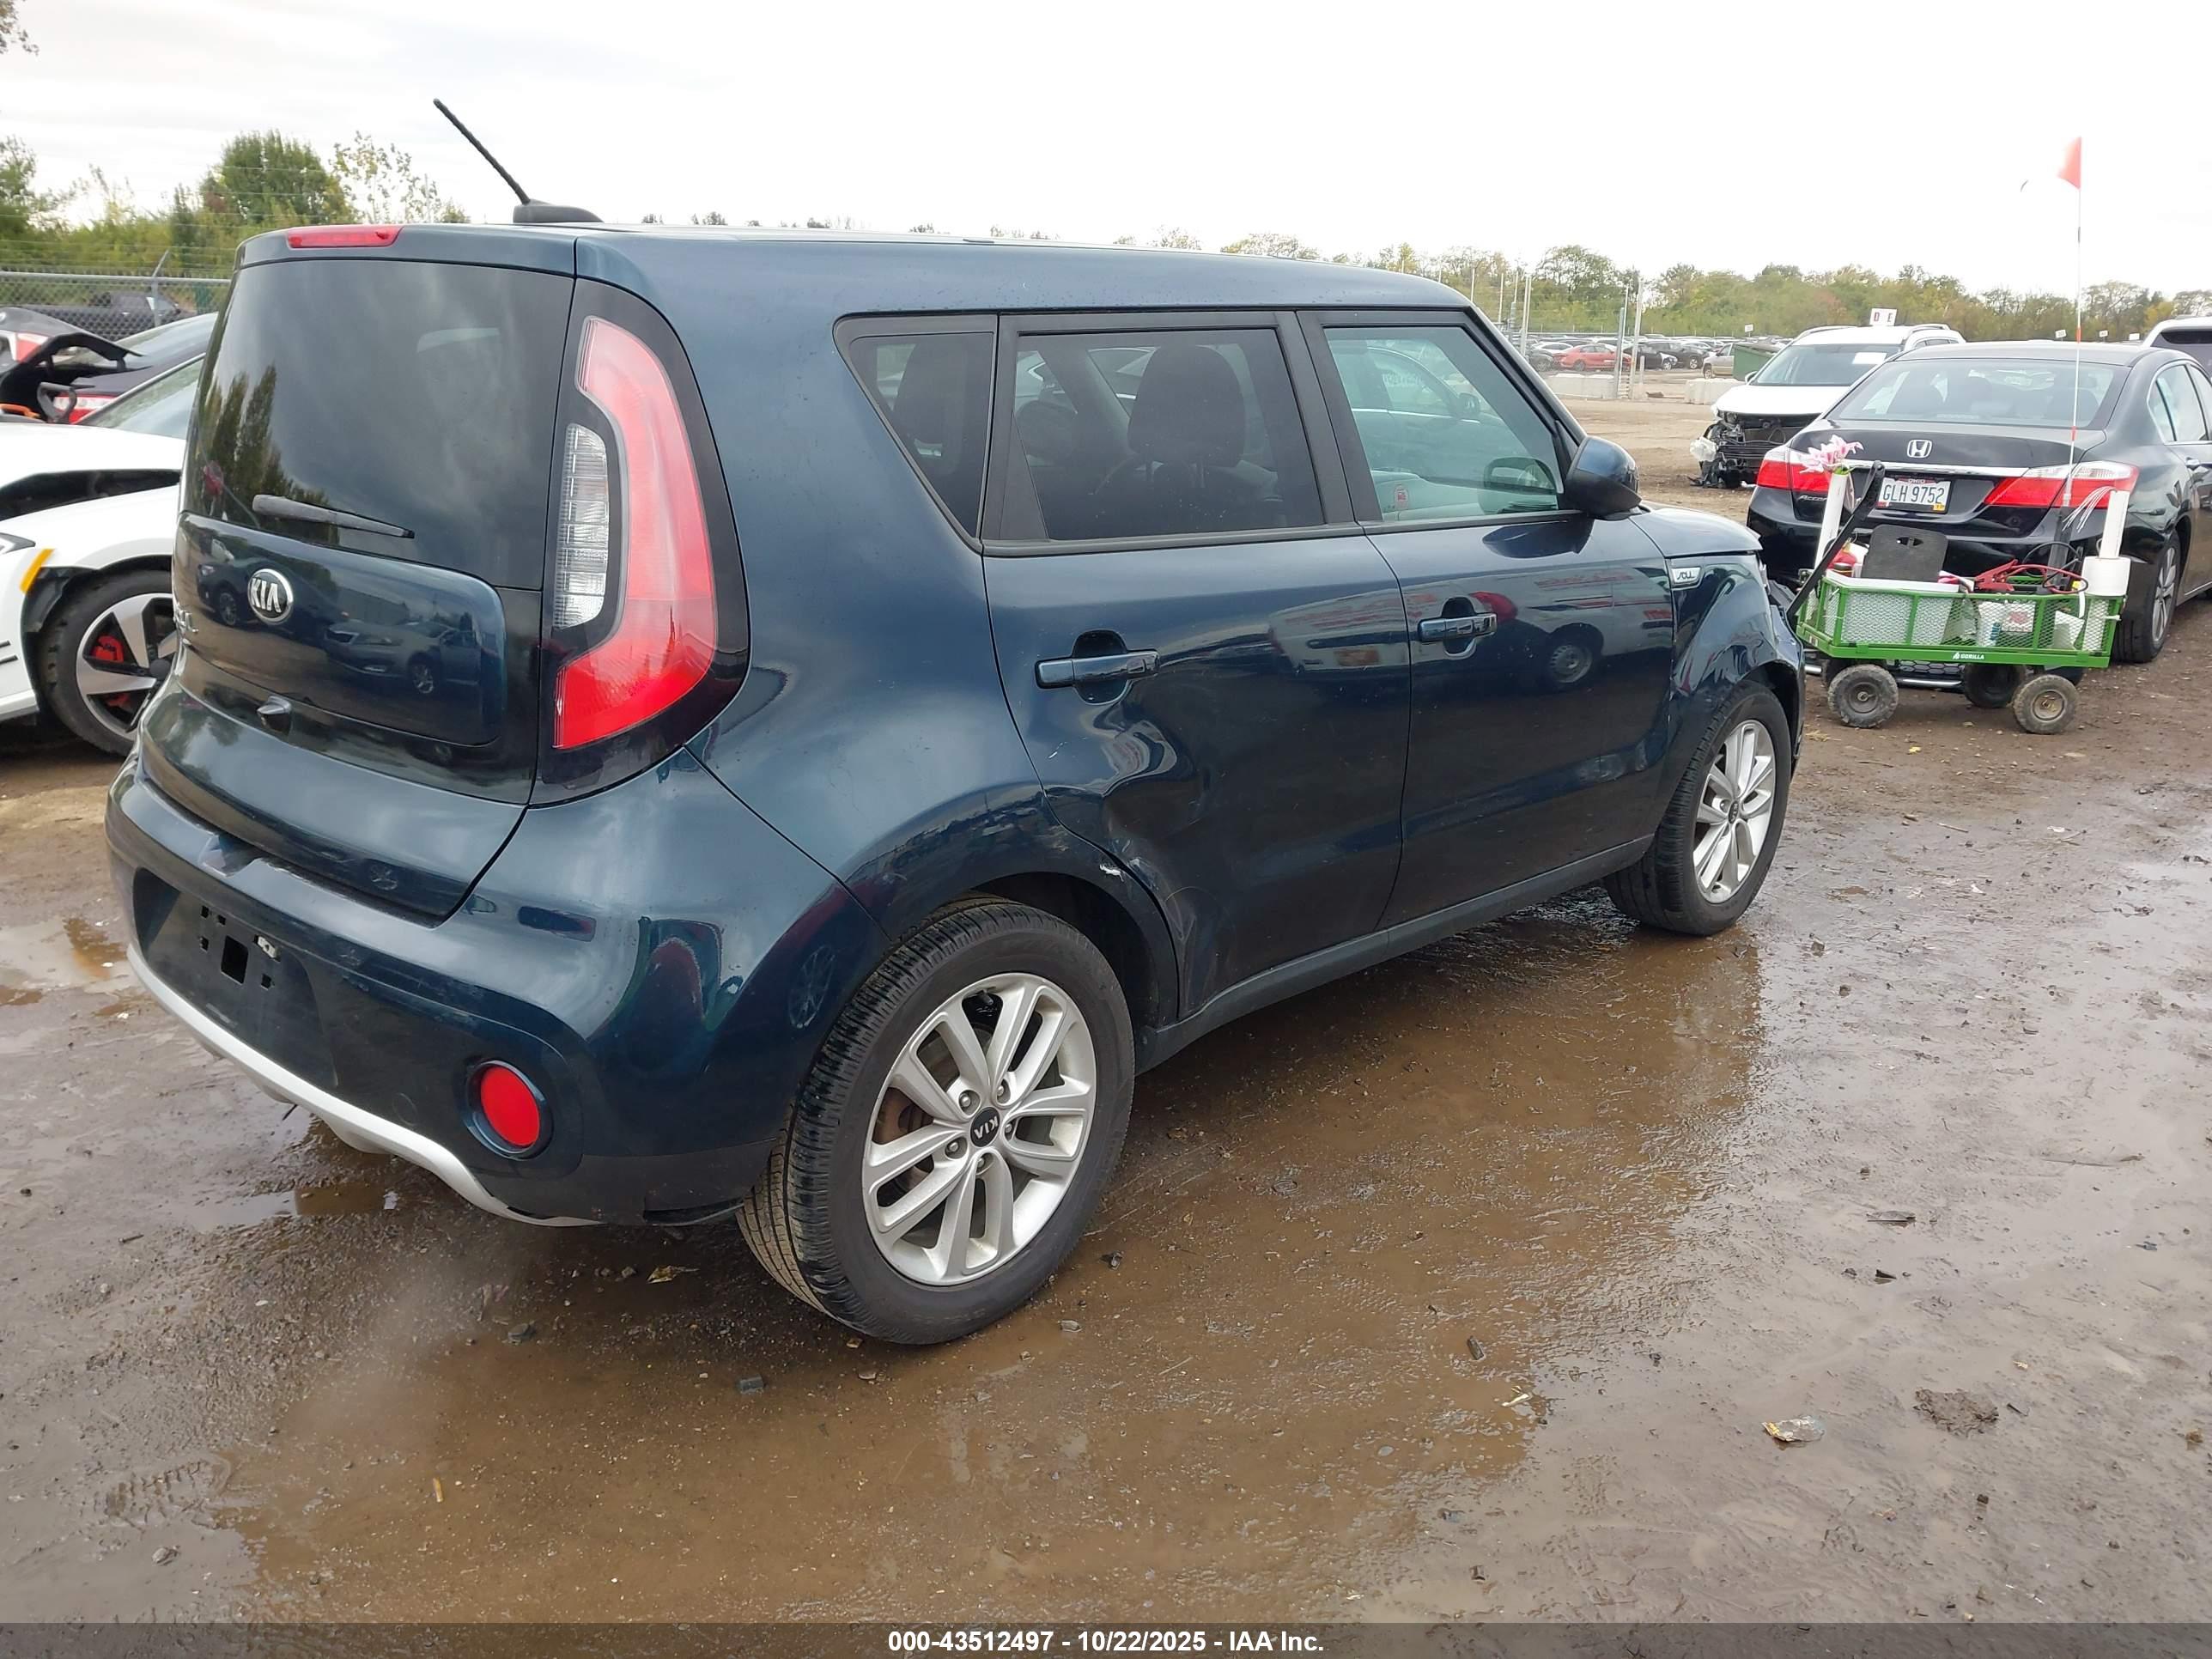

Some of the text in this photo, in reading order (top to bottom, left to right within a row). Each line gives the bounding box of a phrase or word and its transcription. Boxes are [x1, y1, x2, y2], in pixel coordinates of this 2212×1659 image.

[1882, 484, 1945, 504] GLH 9752
[250, 577, 282, 613] KIA
[974, 1115, 999, 1139] KIA
